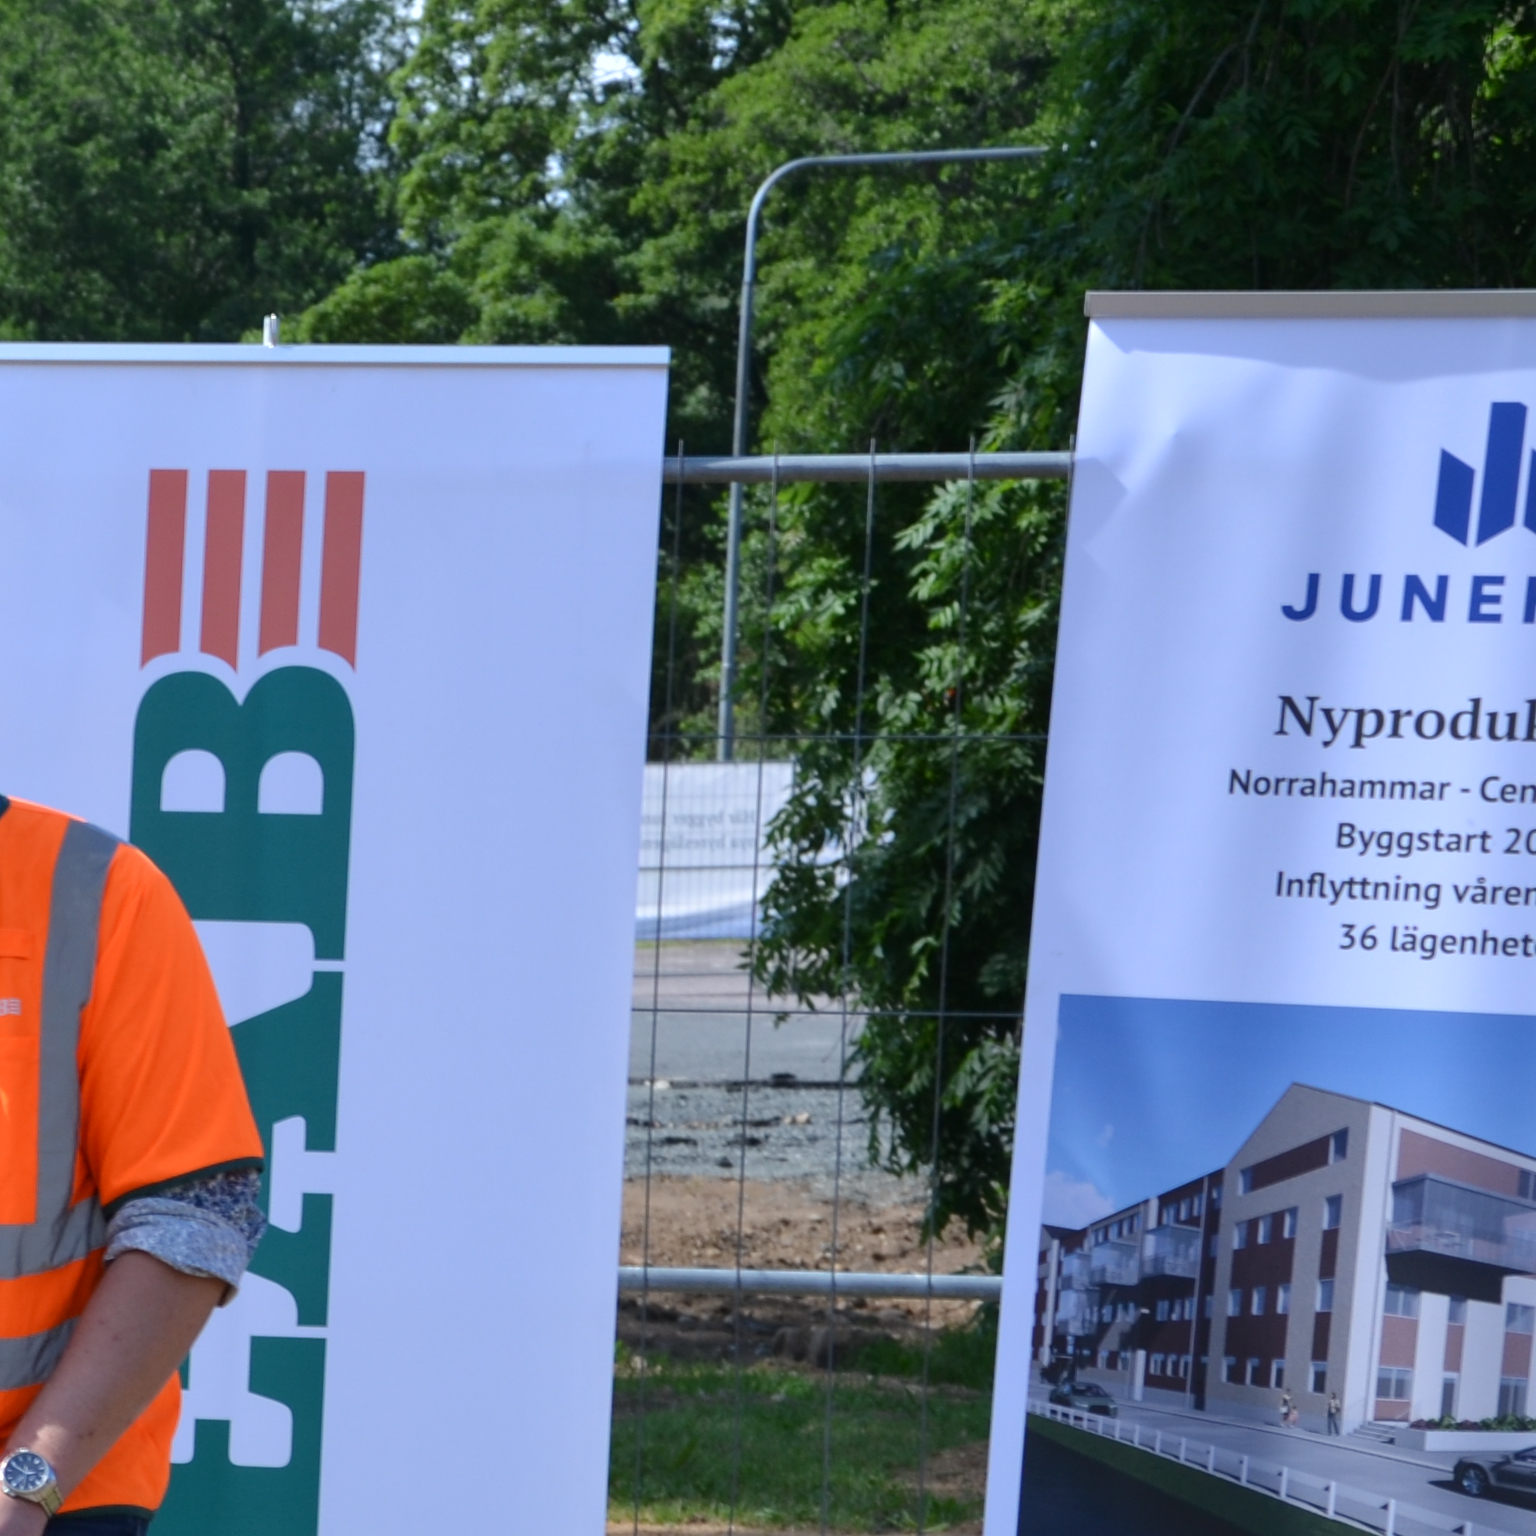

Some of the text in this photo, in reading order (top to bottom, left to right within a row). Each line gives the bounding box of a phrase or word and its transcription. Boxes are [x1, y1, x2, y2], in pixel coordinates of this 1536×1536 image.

[1228, 769, 1450, 801] Norrahammar
[1336, 822, 1491, 858] Byggstart
[1275, 871, 1442, 910] Inflyttning
[1339, 923, 1536, 960] 36 lägenhet
